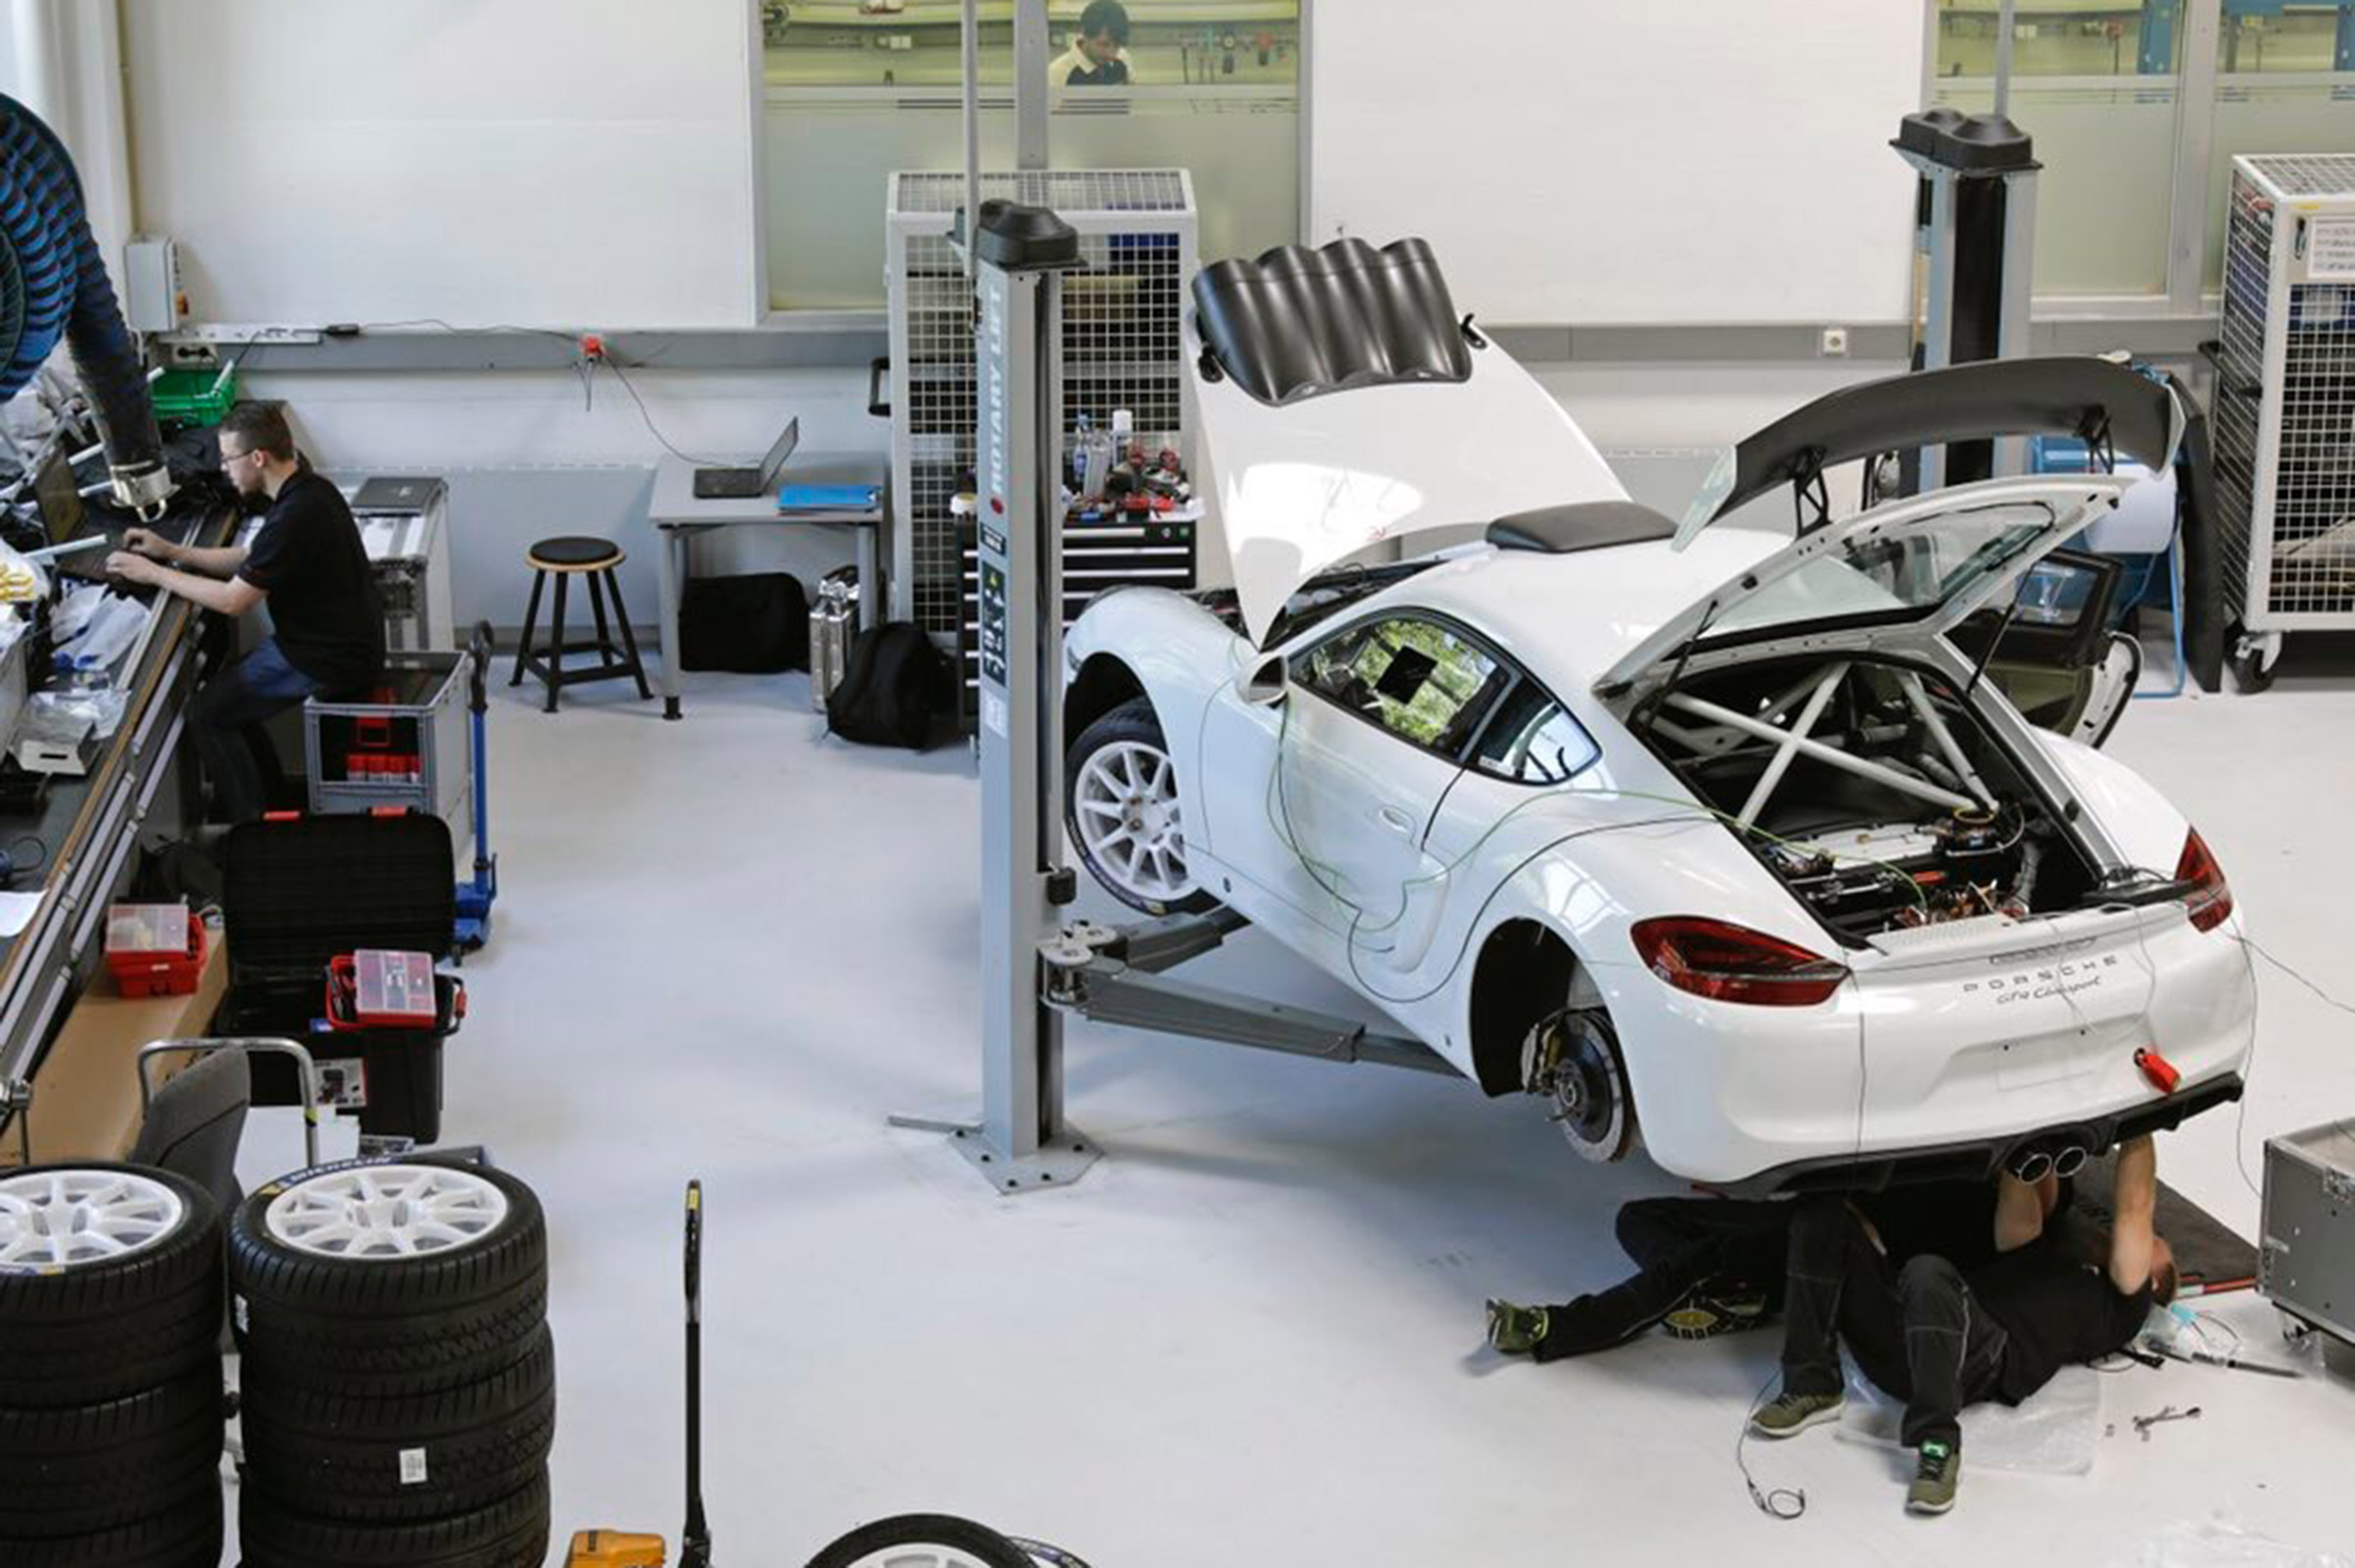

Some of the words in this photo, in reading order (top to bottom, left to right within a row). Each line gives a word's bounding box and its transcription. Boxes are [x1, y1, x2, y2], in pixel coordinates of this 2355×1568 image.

[990, 286, 1002, 355] LIFT
[990, 363, 1003, 494] ROTARY
[1962, 955, 2117, 992] PORSCHE
[293, 1156, 392, 1181] MICHELIN
